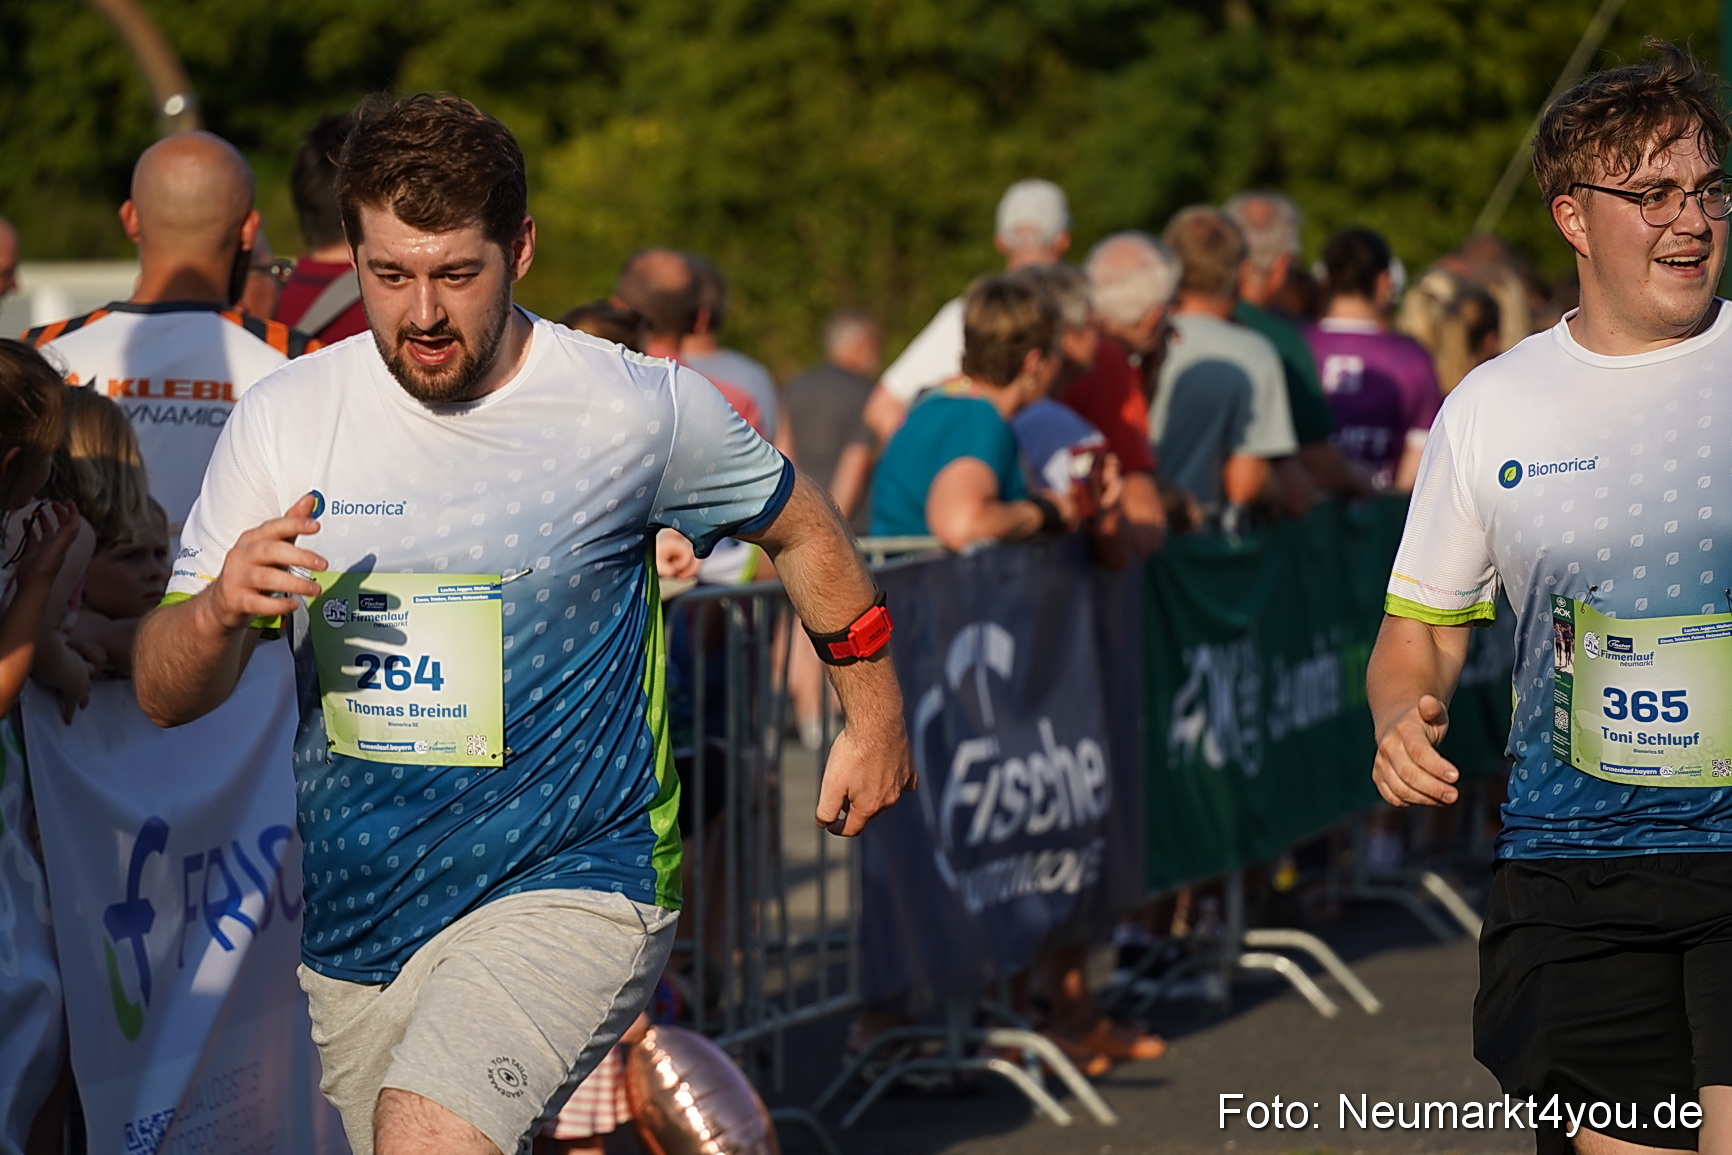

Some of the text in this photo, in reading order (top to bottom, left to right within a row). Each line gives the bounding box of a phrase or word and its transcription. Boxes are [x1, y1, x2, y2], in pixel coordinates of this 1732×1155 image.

[1528, 457, 1597, 477] Bionorica
[332, 500, 404, 516] Bionorica
[351, 611, 409, 622] Firmenlauf
[1553, 606, 1571, 619] AOK
[373, 620, 408, 629] neumarkt
[1601, 649, 1655, 662] Firmenlauf
[355, 654, 445, 691] 264
[345, 698, 468, 718] Thomas Breindl
[1603, 687, 1689, 723] 365
[1601, 726, 1700, 748] Toni Schlupf
[360, 742, 413, 752] firmenlauf.bayern
[1602, 764, 1658, 775] firmenlauf.bayern
[490, 1056, 510, 1066] TOM
[511, 1058, 528, 1087] TAILOR
